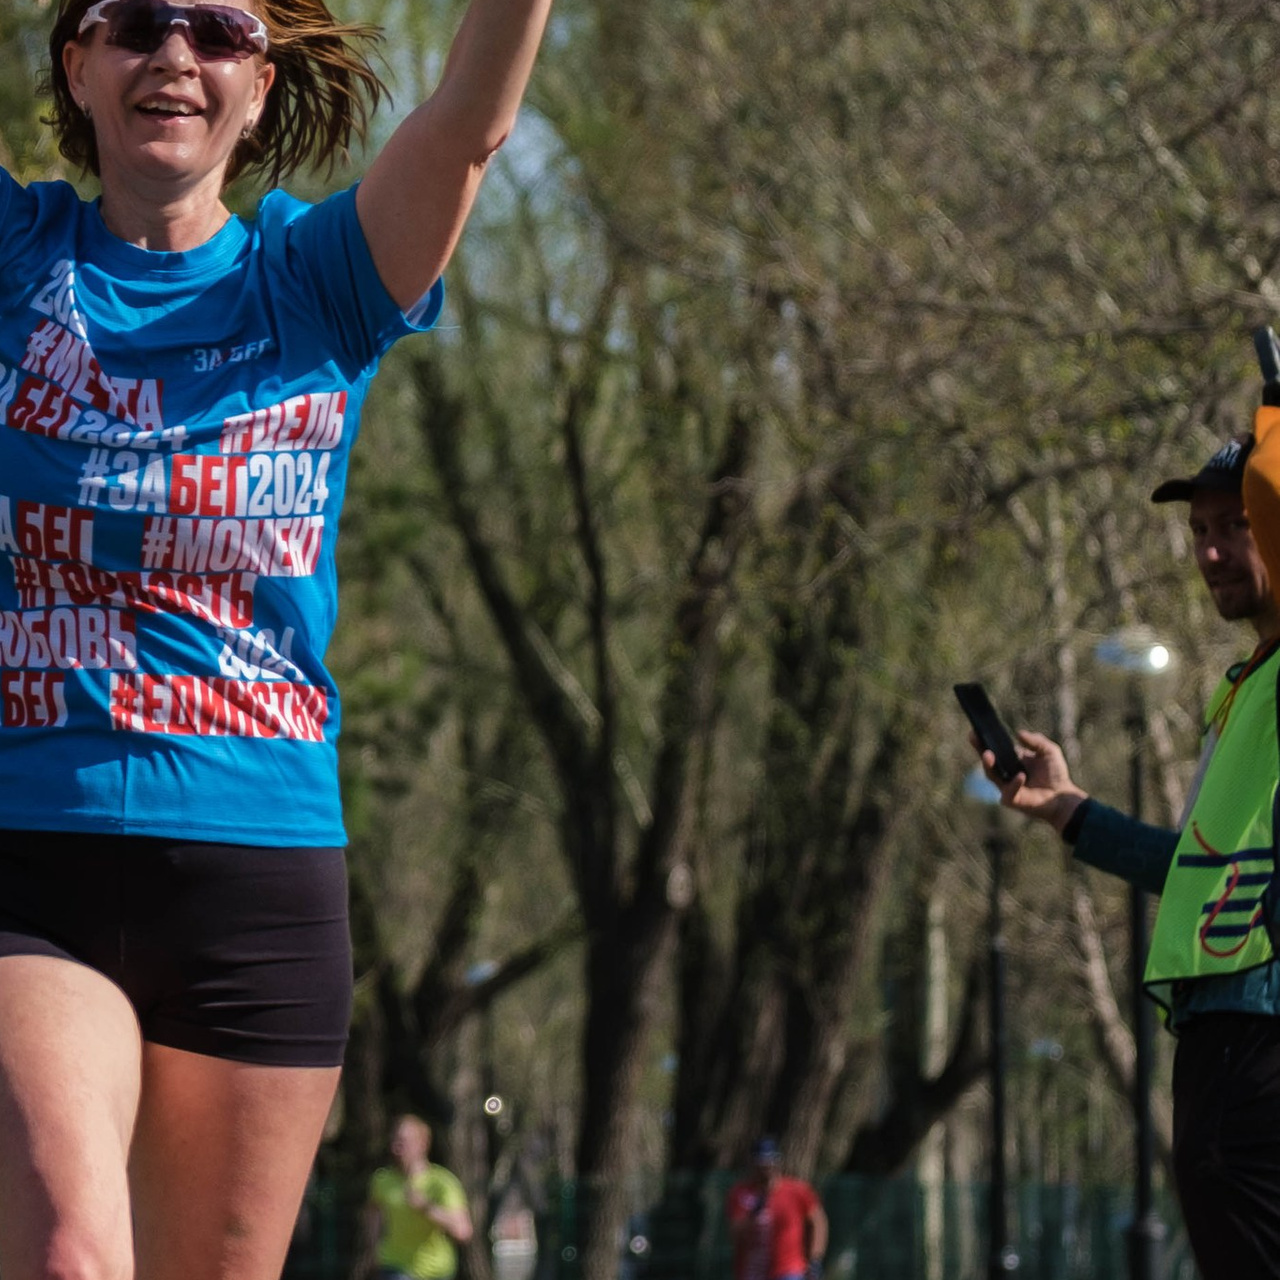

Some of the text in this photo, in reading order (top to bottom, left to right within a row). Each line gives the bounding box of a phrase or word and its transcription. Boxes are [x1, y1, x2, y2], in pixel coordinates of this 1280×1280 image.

[220, 391, 347, 454] #ЦЕЛЬ
[77, 447, 331, 518] #ЗАБЕГ2024
[140, 514, 325, 577] #МОМЕНТ
[11, 557, 259, 630] #ГОРДОСТЬ
